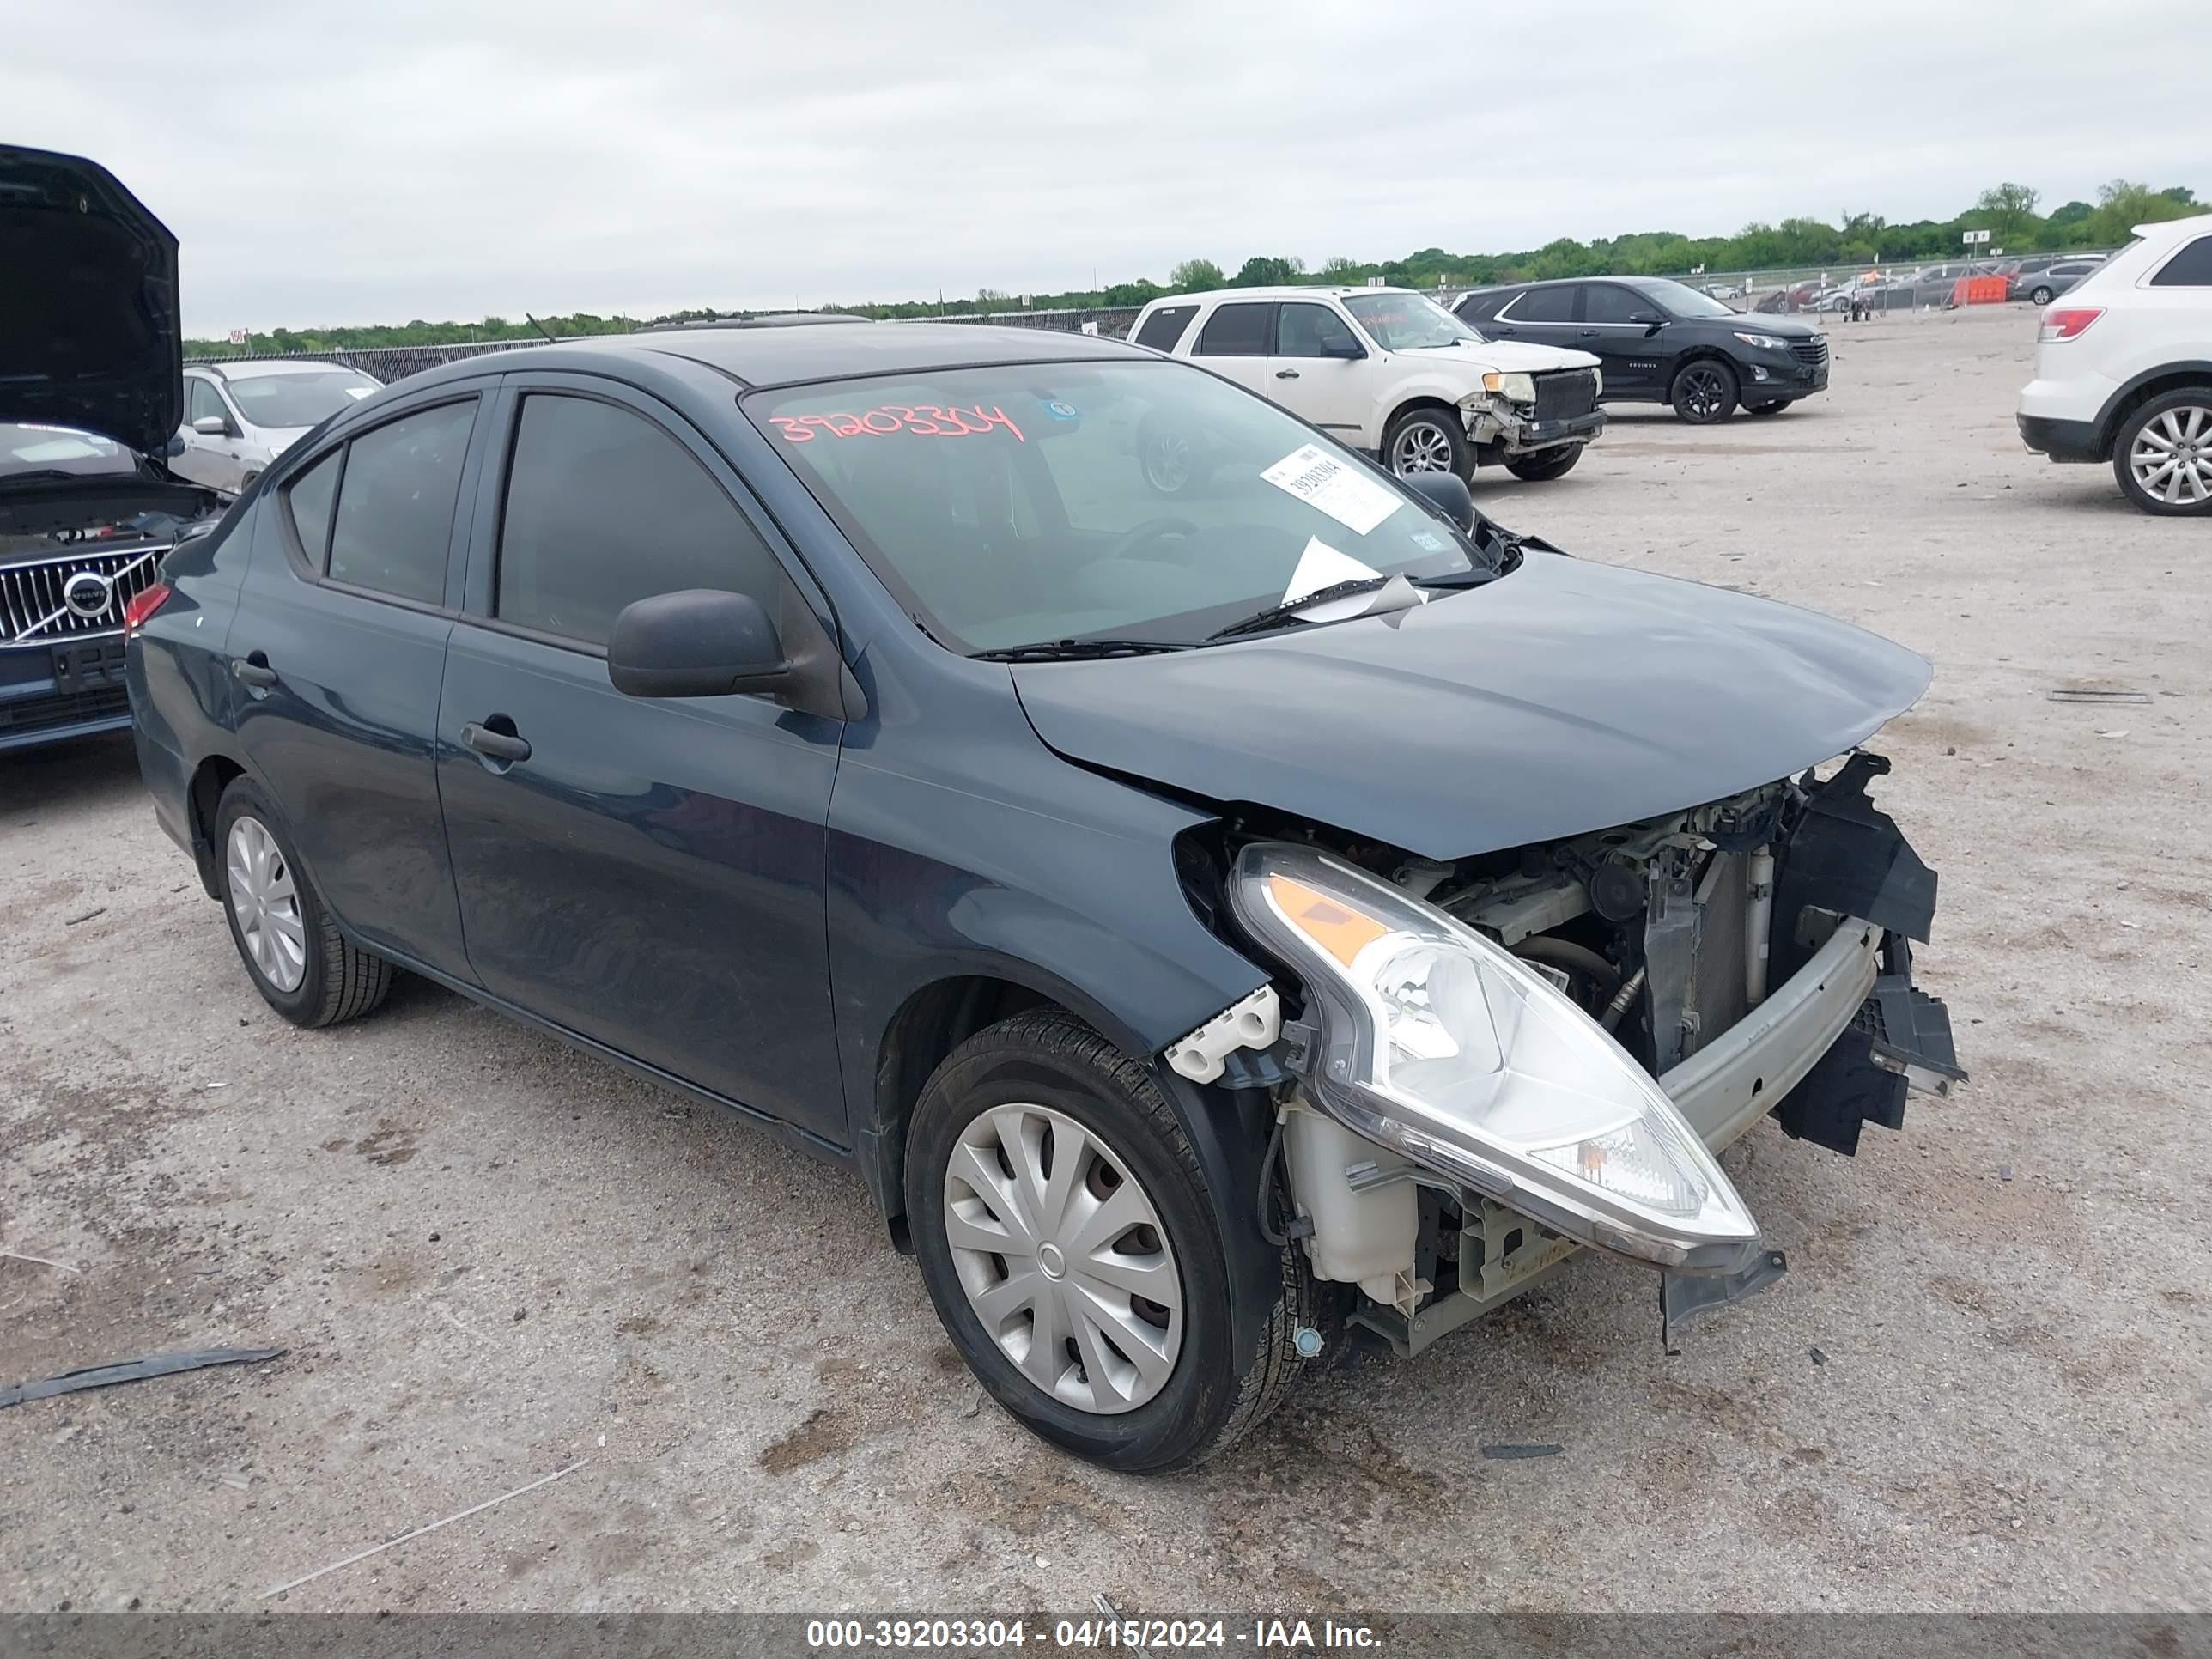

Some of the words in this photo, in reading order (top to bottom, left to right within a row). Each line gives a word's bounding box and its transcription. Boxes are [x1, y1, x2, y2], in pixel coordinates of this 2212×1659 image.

[769, 404, 1024, 442] 39203304
[1290, 459, 1342, 495] 39203304
[72, 590, 106, 600] VOLVO
